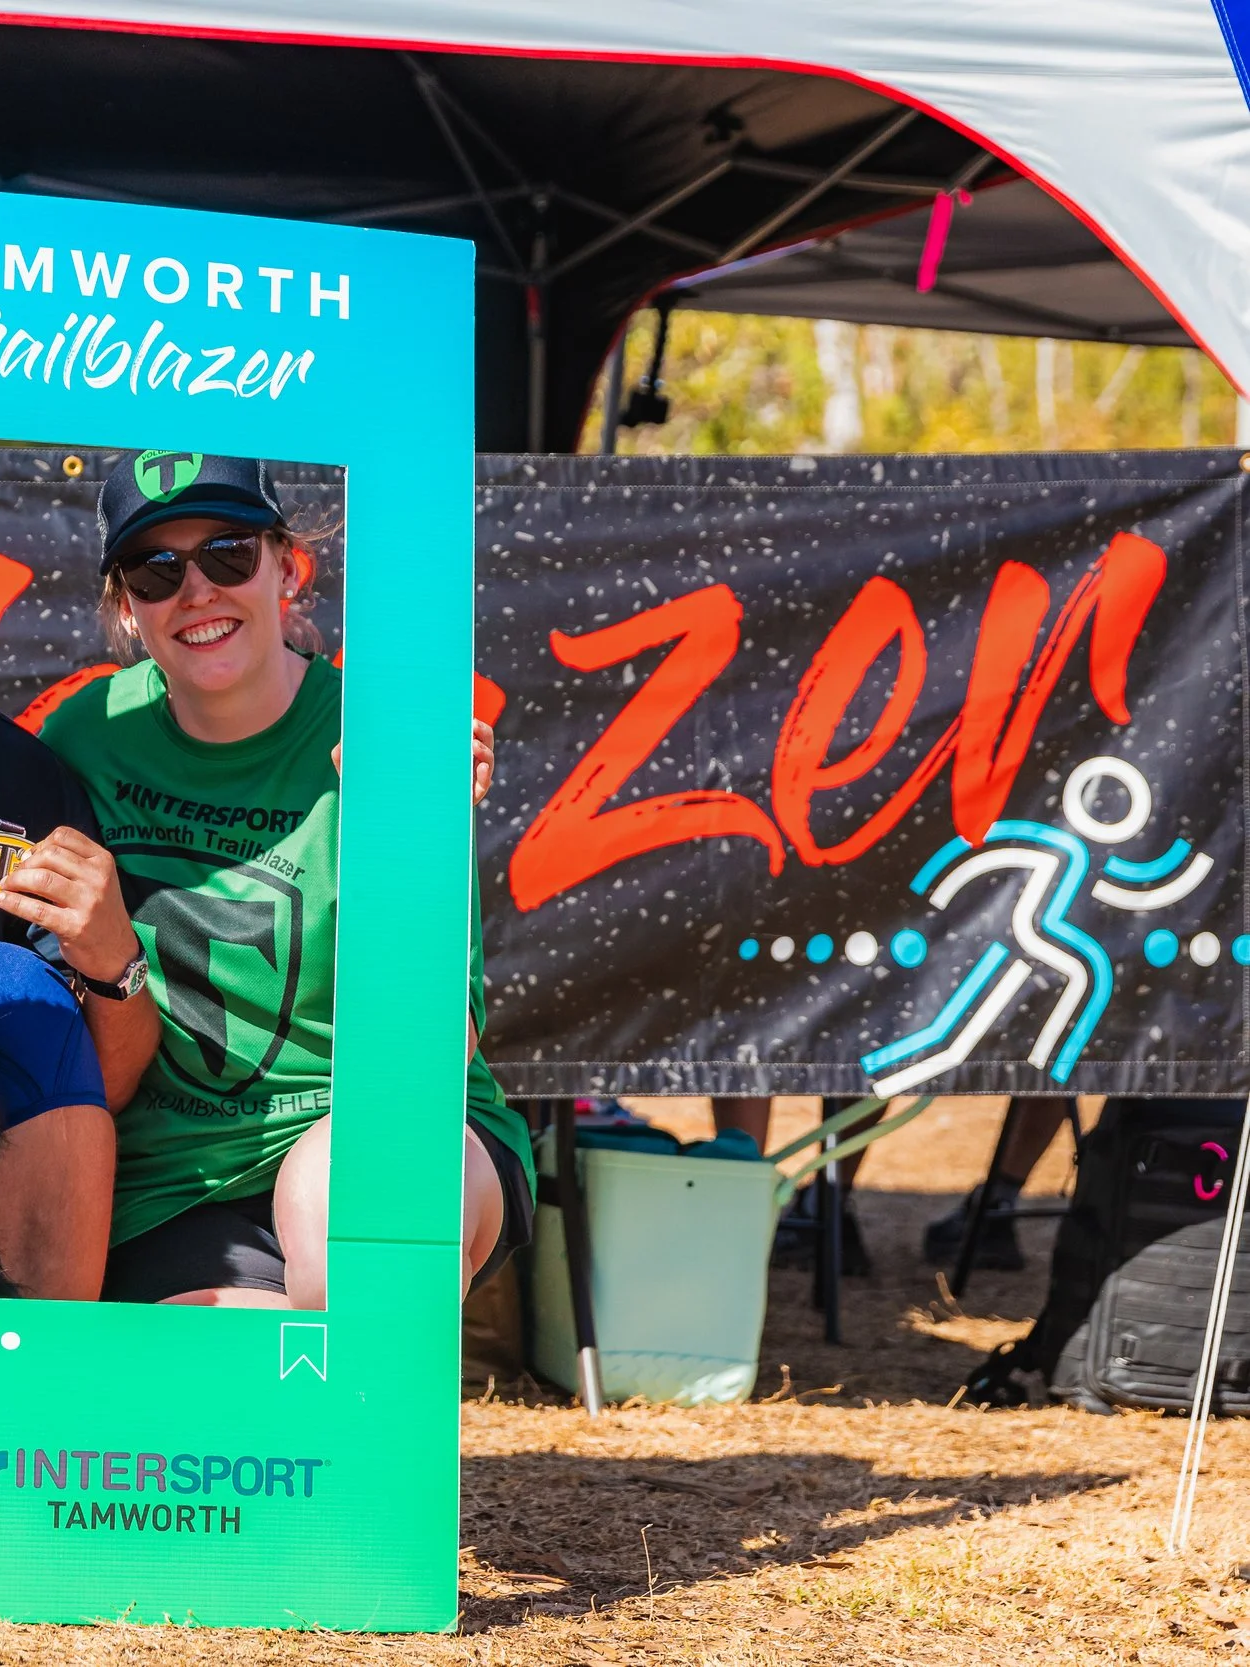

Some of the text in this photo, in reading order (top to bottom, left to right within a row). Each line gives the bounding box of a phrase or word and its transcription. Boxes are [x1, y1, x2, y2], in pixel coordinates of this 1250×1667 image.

[130, 782, 304, 834] INTERSPORT
[98, 823, 306, 881] amworth Trailblazer
[15, 1448, 325, 1498] INTERSPORT
[47, 1501, 241, 1534] TAMWORTH
